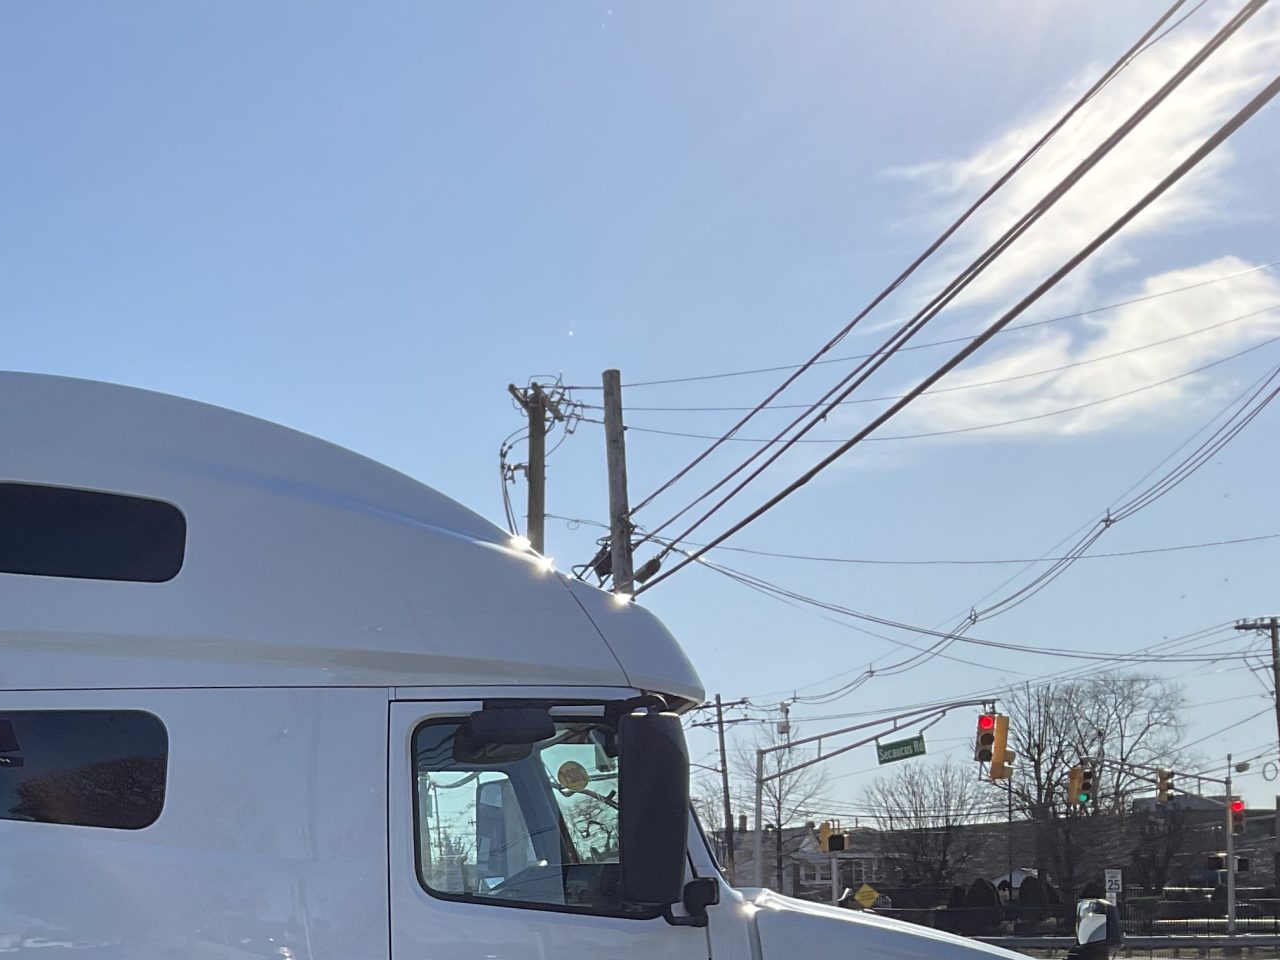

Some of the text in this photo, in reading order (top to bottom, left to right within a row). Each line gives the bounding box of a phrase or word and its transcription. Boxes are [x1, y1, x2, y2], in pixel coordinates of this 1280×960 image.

[878, 739, 924, 761] Secaucus Rd
[1107, 879, 1120, 890] 25
